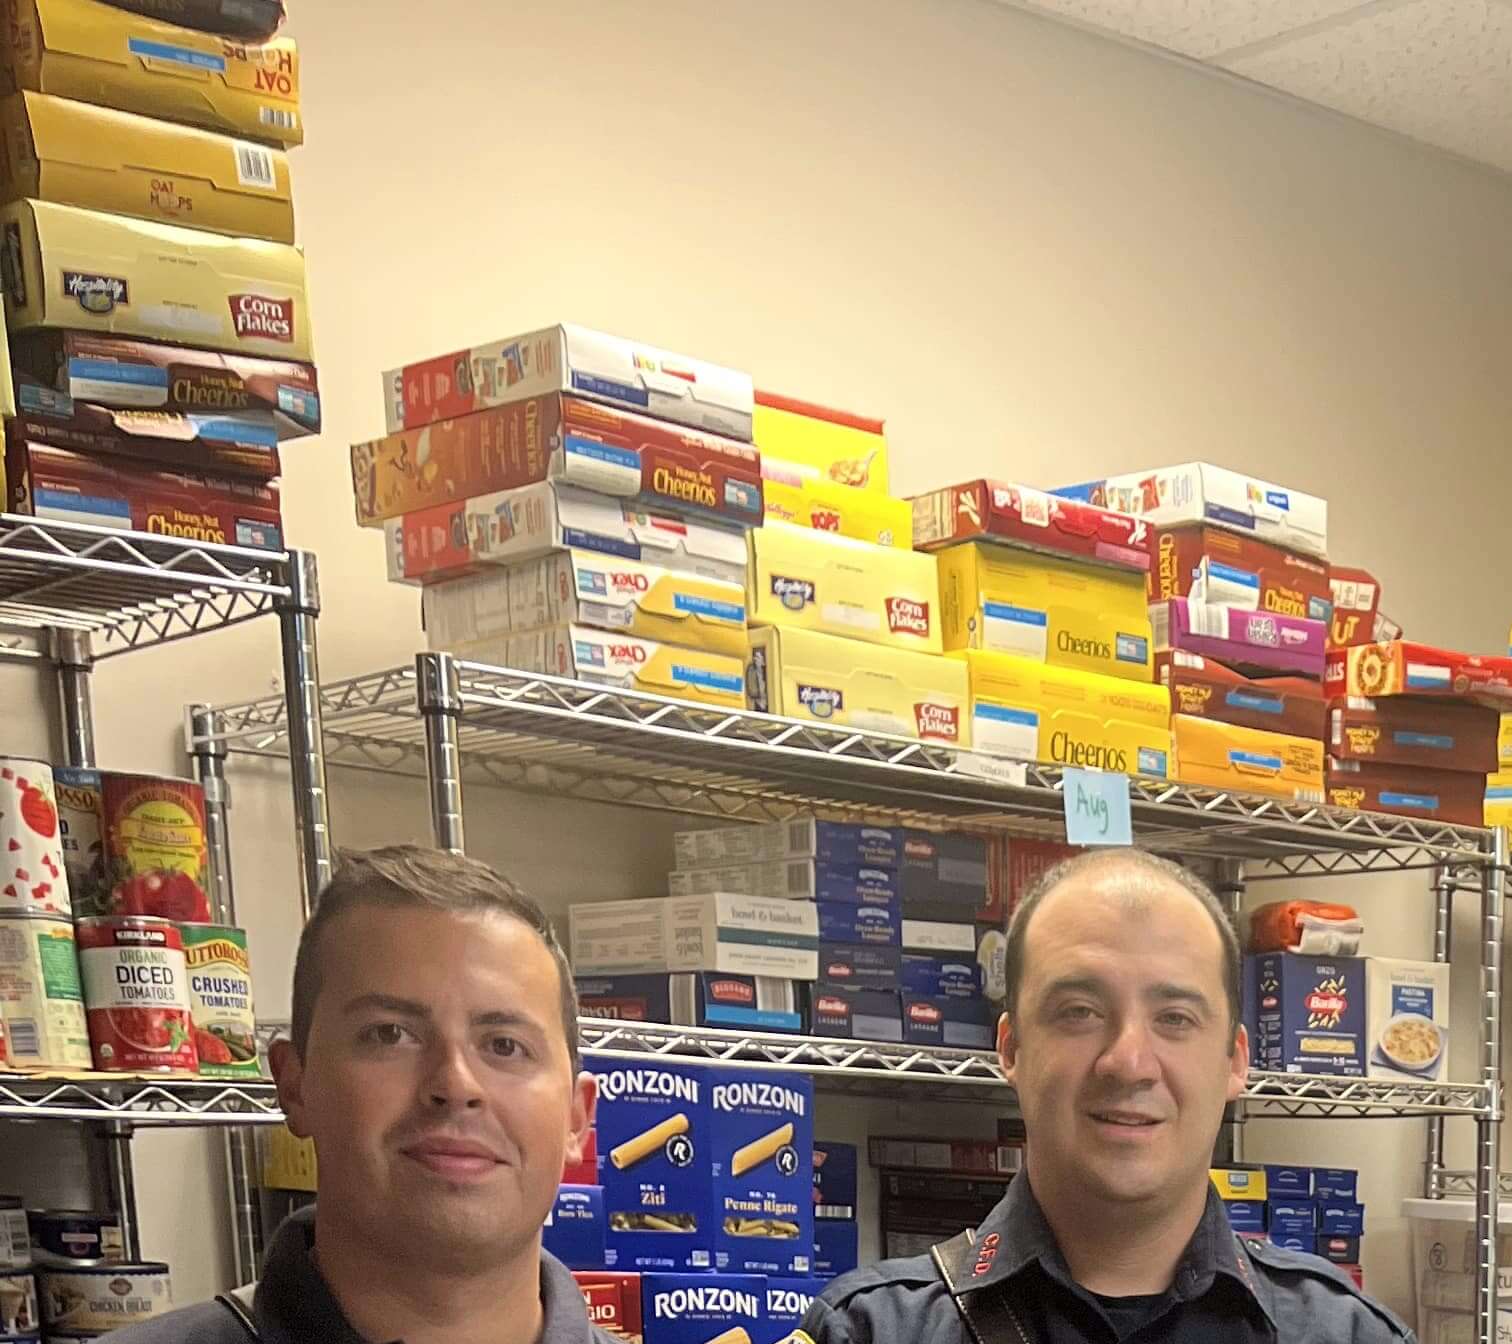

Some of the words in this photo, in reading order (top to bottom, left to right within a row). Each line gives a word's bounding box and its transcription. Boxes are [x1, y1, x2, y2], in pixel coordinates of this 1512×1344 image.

[239, 295, 283, 319] Corn
[237, 312, 290, 335] Flakes
[172, 378, 249, 407] Cheerios
[652, 467, 717, 507] Cheerios
[890, 599, 923, 617] Corn
[890, 611, 928, 631] Flakes
[1057, 630, 1111, 660] Cheerios
[920, 702, 952, 721] Corn
[919, 716, 956, 736] Flakes
[1050, 731, 1127, 772] Cheerios
[1075, 783, 1109, 834] Aug
[120, 950, 168, 965] ORGANIC
[116, 965, 174, 985] DICED
[121, 986, 175, 1000] TOMATOES
[597, 1069, 698, 1103] RONZONI
[712, 1082, 804, 1116] RONZONI
[641, 1191, 666, 1205] Ziti
[724, 1197, 761, 1213] Penne
[764, 1199, 799, 1215] Rigate
[654, 1287, 760, 1319] RONZONI
